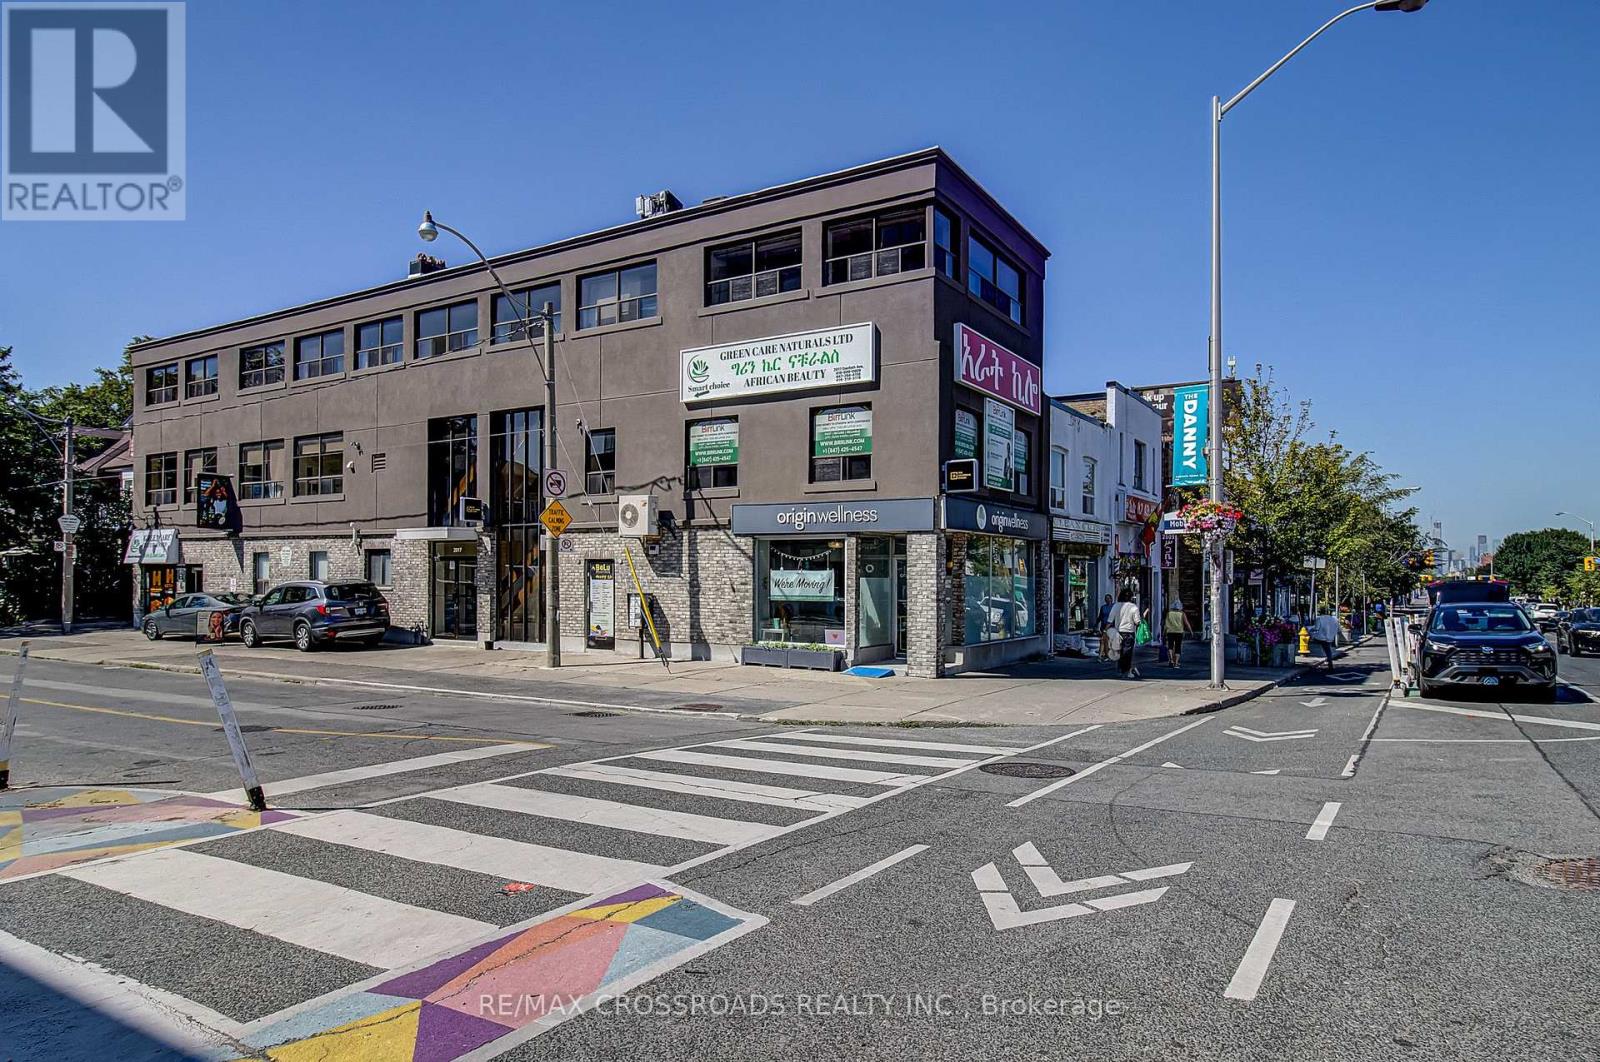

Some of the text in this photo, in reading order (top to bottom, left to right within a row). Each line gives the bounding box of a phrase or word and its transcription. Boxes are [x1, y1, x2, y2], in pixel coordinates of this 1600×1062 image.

[719, 333, 853, 361] GREEN CARE NATURALS LTD
[743, 373, 785, 388] AFRICAN
[787, 369, 827, 383] BEAUTY
[961, 333, 1038, 408] አራት ኪሎ
[687, 381, 731, 393] Smart choice
[1153, 393, 1165, 403] up
[1183, 400, 1198, 470] DANNY
[548, 516, 565, 524] CALMING
[773, 577, 831, 594] We're Moving!
